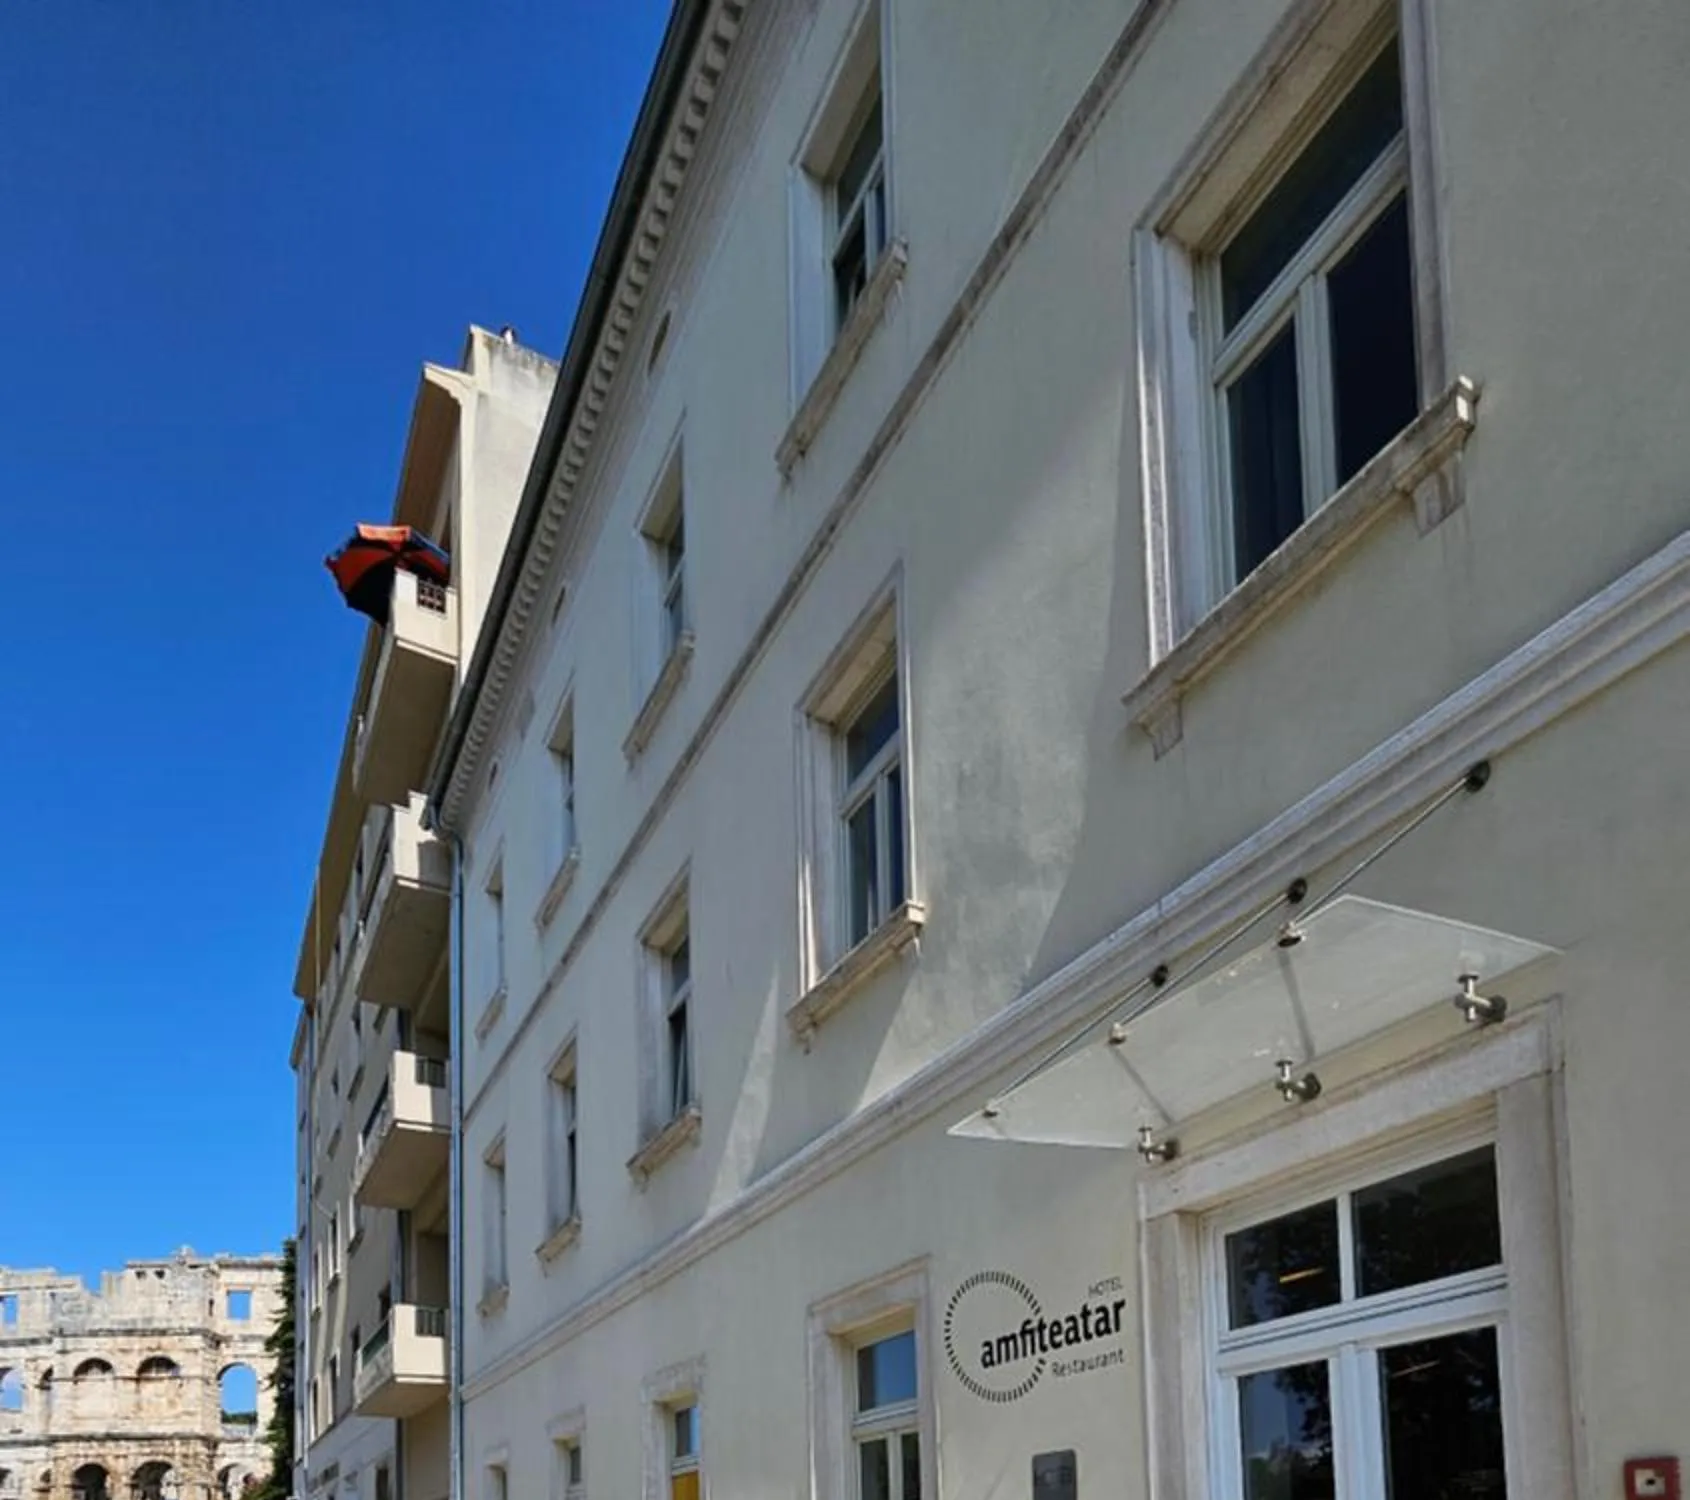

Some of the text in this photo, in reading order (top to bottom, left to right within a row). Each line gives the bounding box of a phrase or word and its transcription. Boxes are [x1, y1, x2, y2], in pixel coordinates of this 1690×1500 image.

[1088, 1276, 1123, 1297] HOTEL
[981, 1299, 1126, 1369] amfiteatar
[1051, 1349, 1124, 1377] Restaurant
